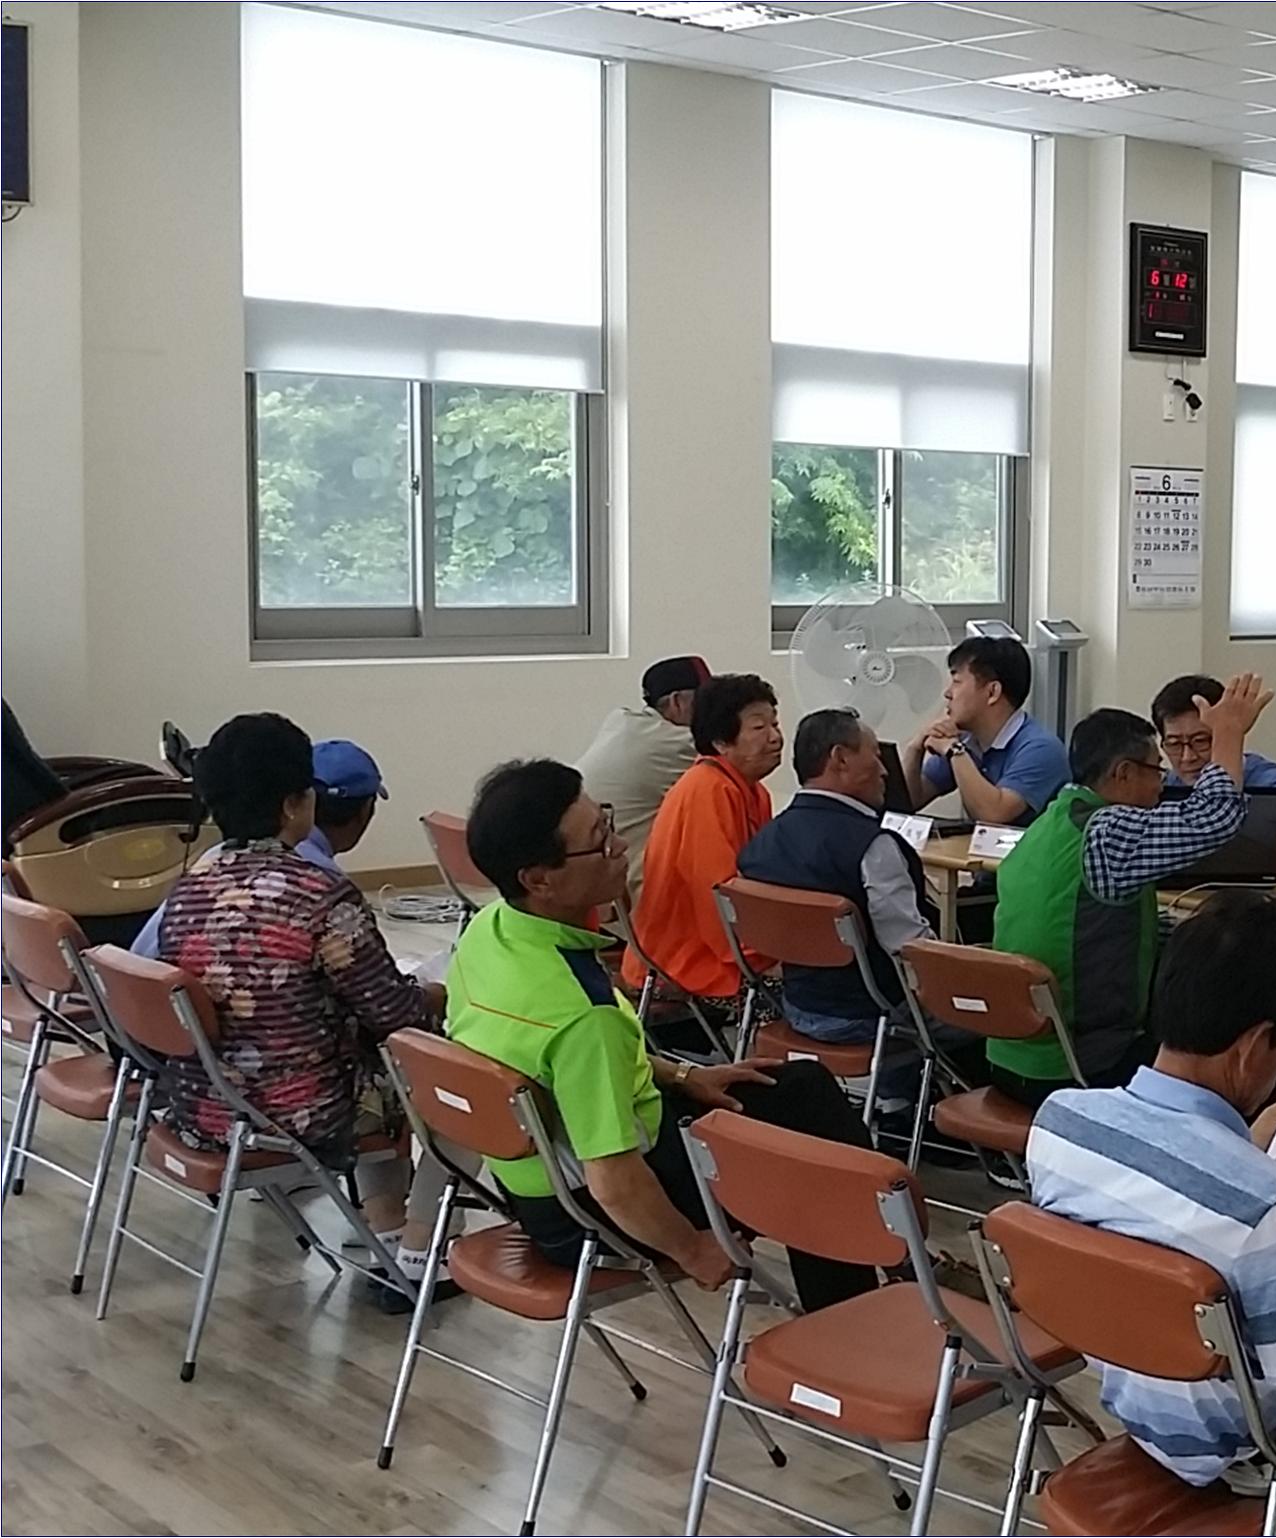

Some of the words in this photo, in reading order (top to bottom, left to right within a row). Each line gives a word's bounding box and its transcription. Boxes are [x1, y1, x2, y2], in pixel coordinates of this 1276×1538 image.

[1151, 270, 1160, 286] 6
[1175, 272, 1188, 288] 12
[1162, 474, 1171, 490] 6
